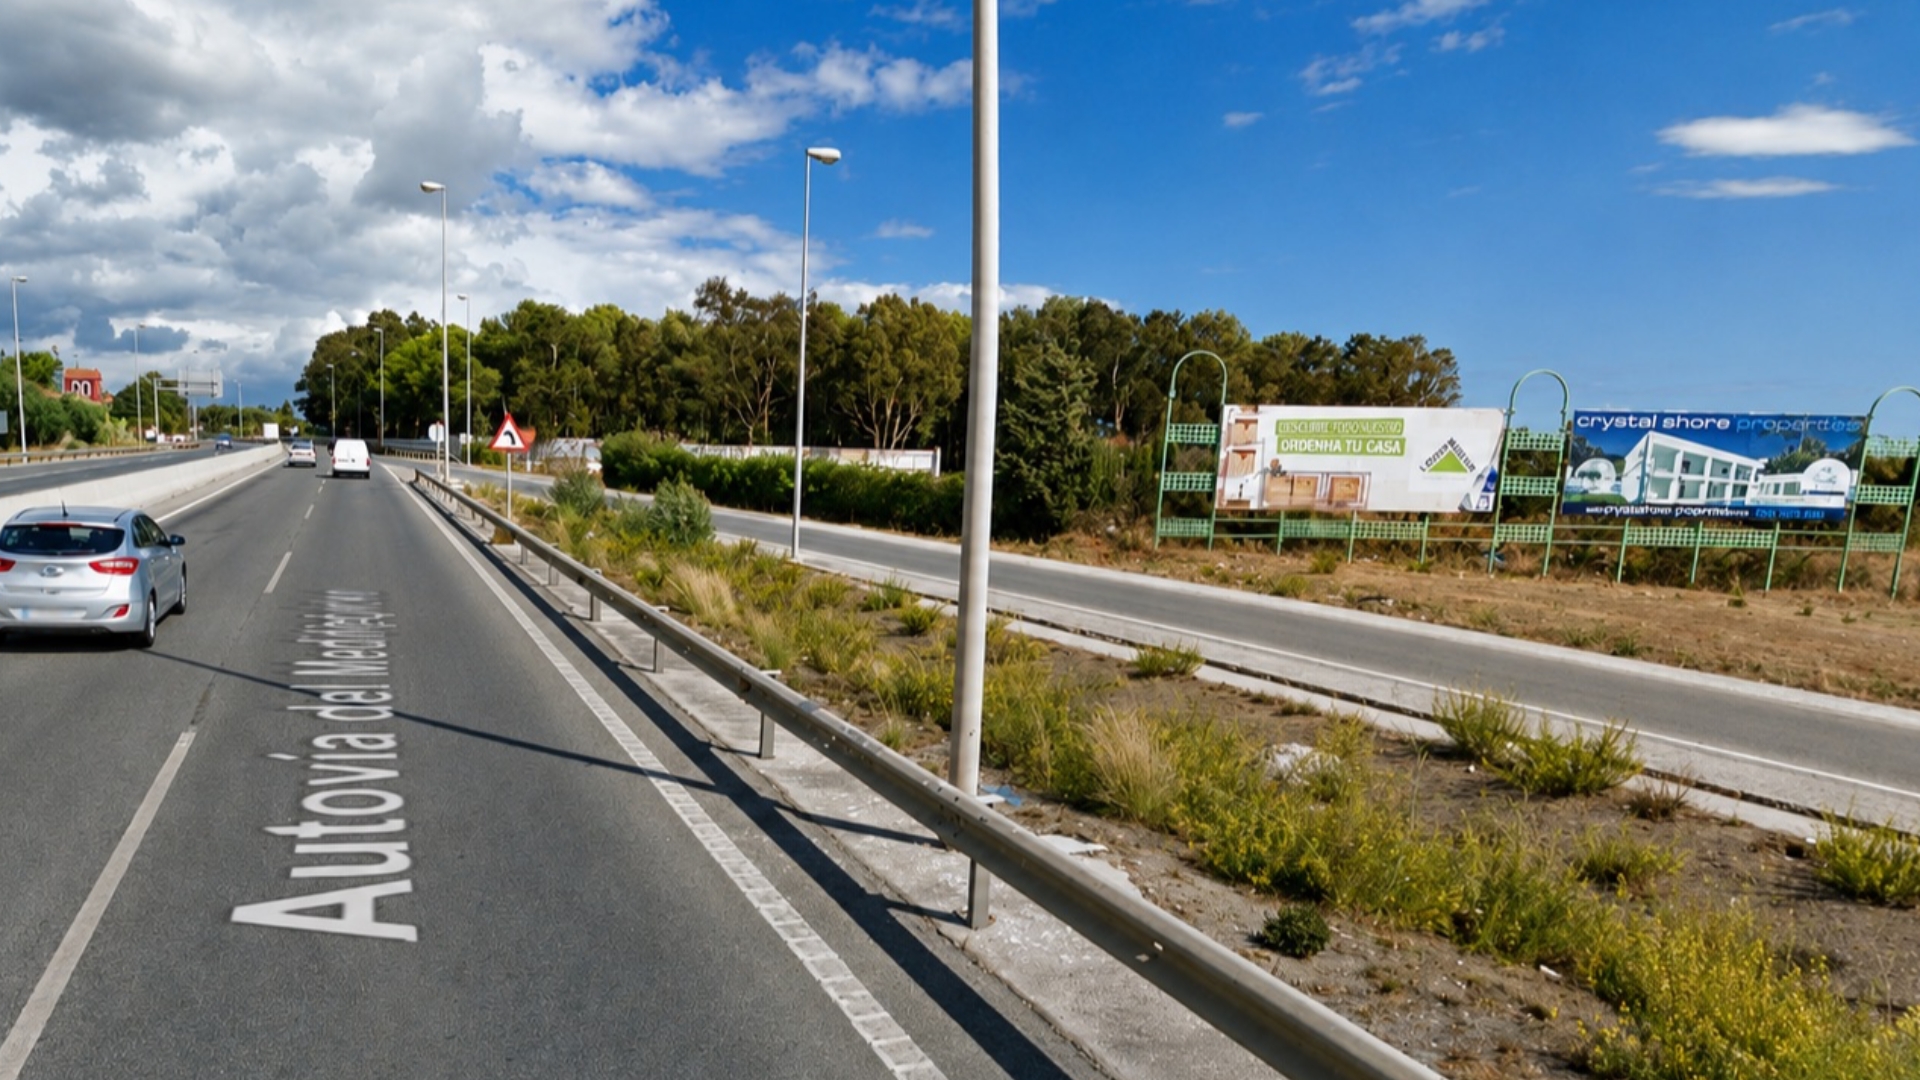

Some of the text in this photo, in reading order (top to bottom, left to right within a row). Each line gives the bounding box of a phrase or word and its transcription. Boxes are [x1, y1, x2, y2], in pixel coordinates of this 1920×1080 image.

[1576, 414, 1657, 432] crystal
[1662, 415, 1730, 430] shore
[1345, 439, 1362, 453] TU
[1366, 439, 1401, 454] CASA
